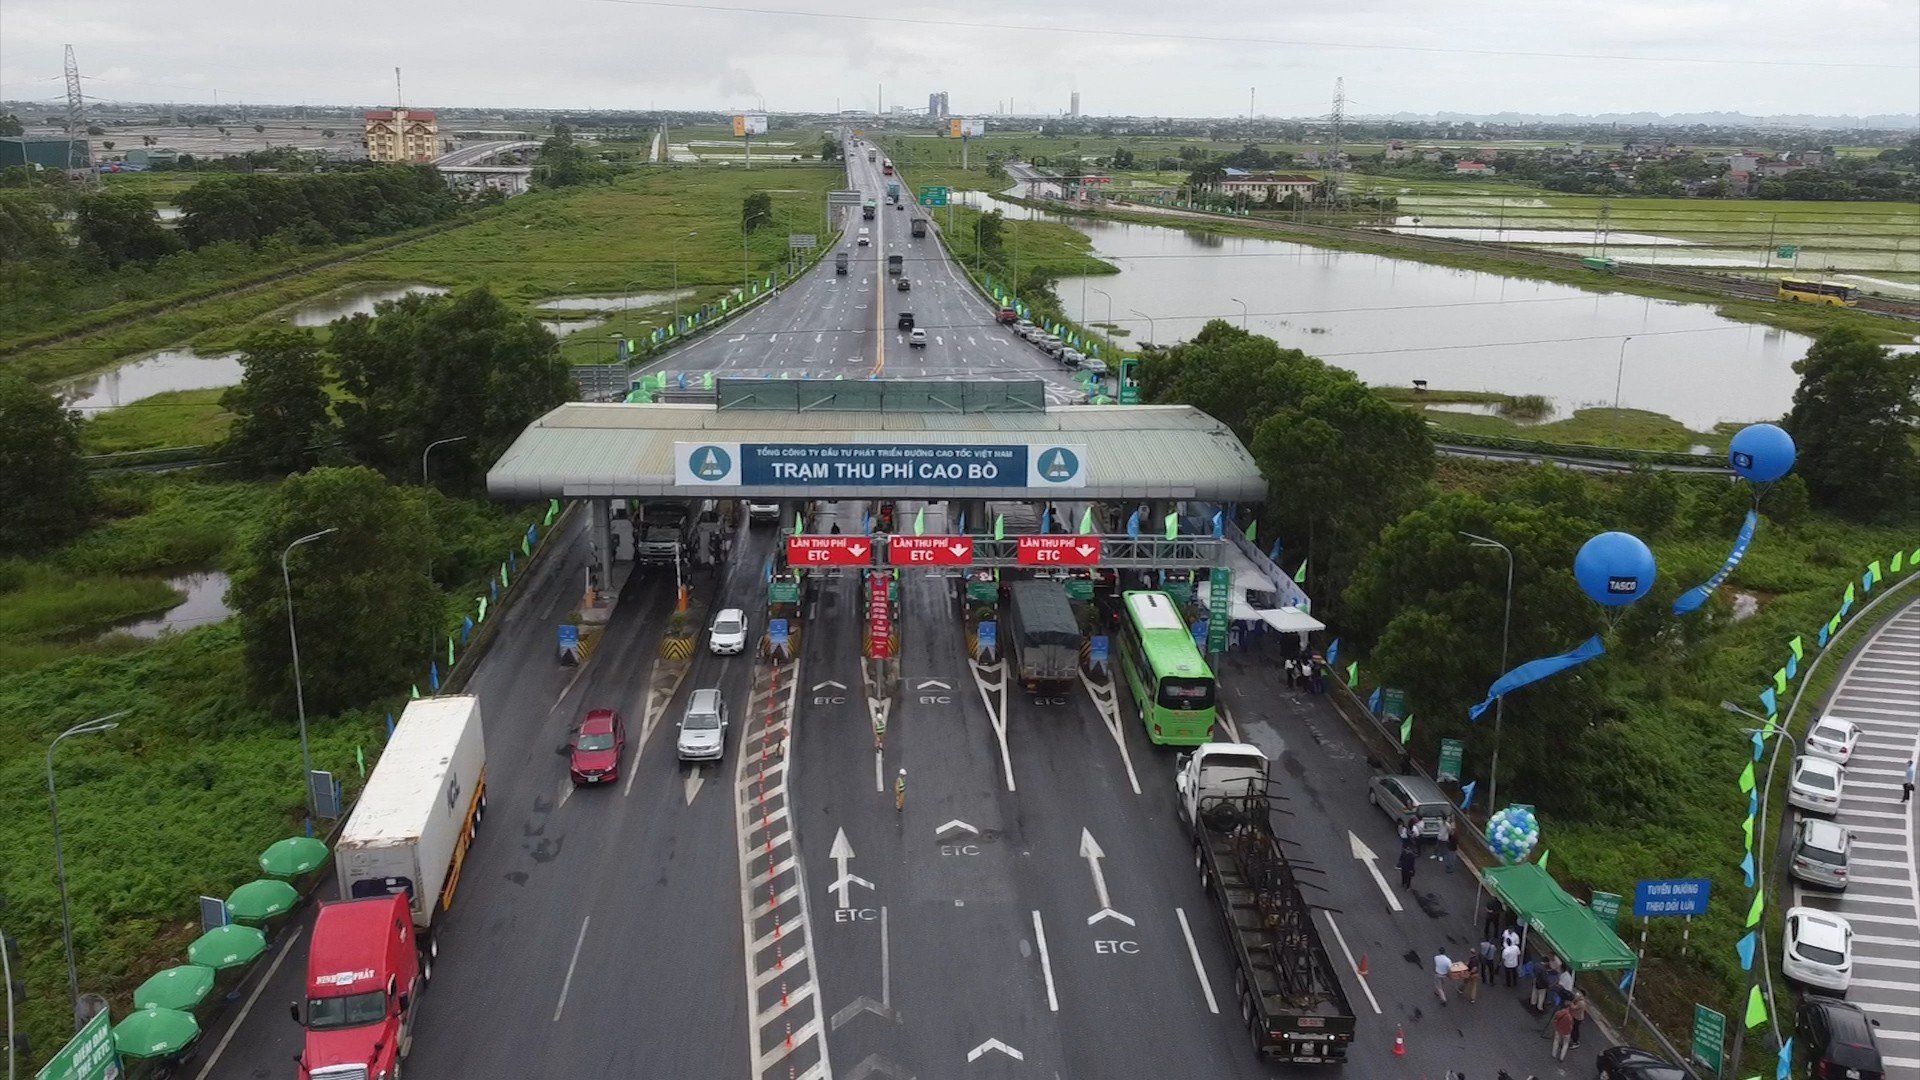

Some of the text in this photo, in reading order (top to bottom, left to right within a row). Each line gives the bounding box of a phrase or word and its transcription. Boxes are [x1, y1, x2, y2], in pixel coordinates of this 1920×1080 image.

[757, 446, 780, 456] TỔNG
[782, 448, 807, 456] CÔNG
[840, 449, 853, 457] TƯ
[853, 448, 876, 457] PHÁT
[955, 448, 972, 458] TỐC
[974, 449, 992, 458] VIỆT
[994, 450, 1013, 458] NAM
[771, 460, 998, 481] TRẠM THU PHÍ CAO BÒ
[791, 537, 847, 547] LÀN THU PHÍ
[893, 537, 949, 547] LÀN THU PHÍ
[1020, 537, 1076, 547] LÀN THU PHÍ
[808, 550, 830, 560] ETC
[911, 550, 934, 560] ETC
[1037, 550, 1060, 560] ETC
[1610, 581, 1637, 590] TASCO
[814, 696, 846, 705] ETC
[919, 696, 952, 704] ETC
[941, 845, 980, 856] ETC
[1646, 901, 1665, 911] THEO
[834, 909, 877, 922] ETC
[1094, 940, 1140, 954] ETC
